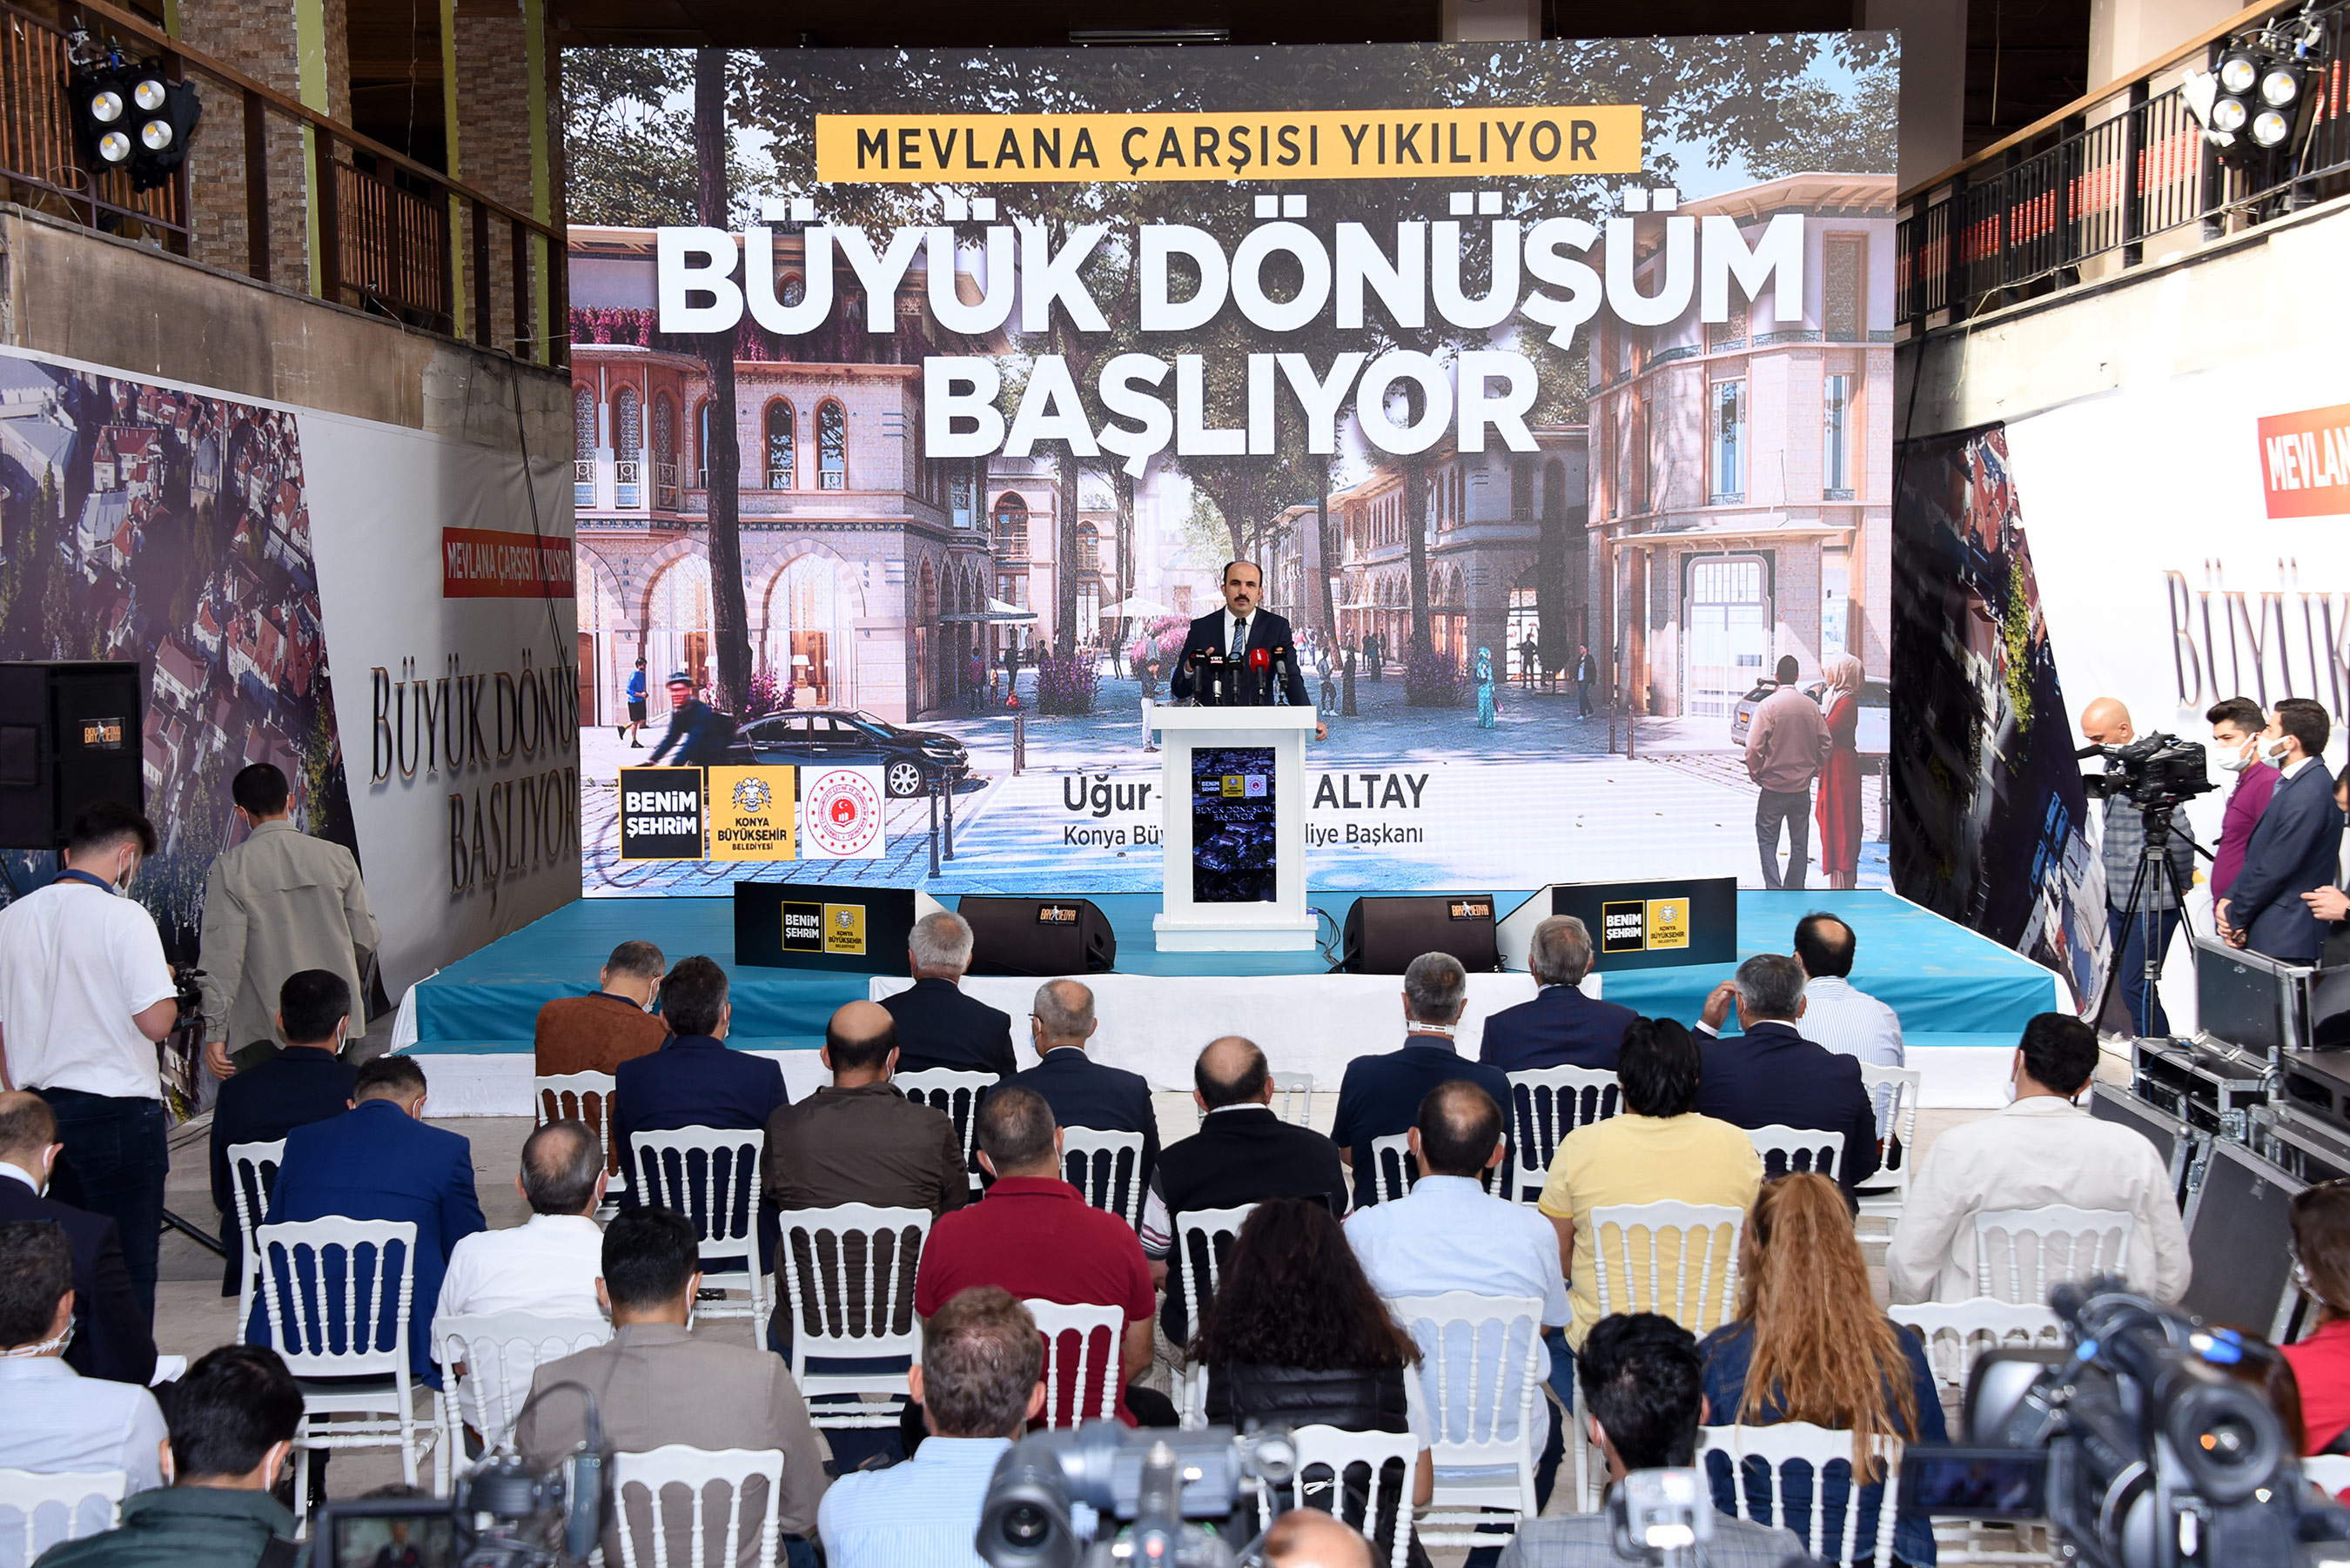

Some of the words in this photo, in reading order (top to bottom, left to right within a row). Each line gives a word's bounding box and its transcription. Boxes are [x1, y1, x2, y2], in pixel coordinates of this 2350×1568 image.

[856, 127, 1100, 170] MEVLANA
[1121, 124, 1318, 177] ÇARŞISI
[1341, 118, 1599, 165] YIKILIYOR
[656, 197, 1112, 336] BÜYÜK
[1138, 188, 1804, 351] DÖNÜŞÜM
[923, 348, 1541, 480] BAŞLIYOR
[446, 542, 497, 579] MEVLANA
[497, 545, 534, 586] ÇARŞISI
[370, 652, 490, 786] BÜYÜK
[1064, 774, 1152, 818] Uğur
[1312, 774, 1429, 809] ALTAY
[448, 766, 581, 920] BAŞLIYOR
[717, 827, 787, 843] BÜYÜKŞEHİR
[735, 817, 769, 827] KONYA
[1064, 825, 1126, 849] Konya
[1346, 822, 1423, 847] Başkanı
[732, 841, 773, 851] BELEDİYESİ
